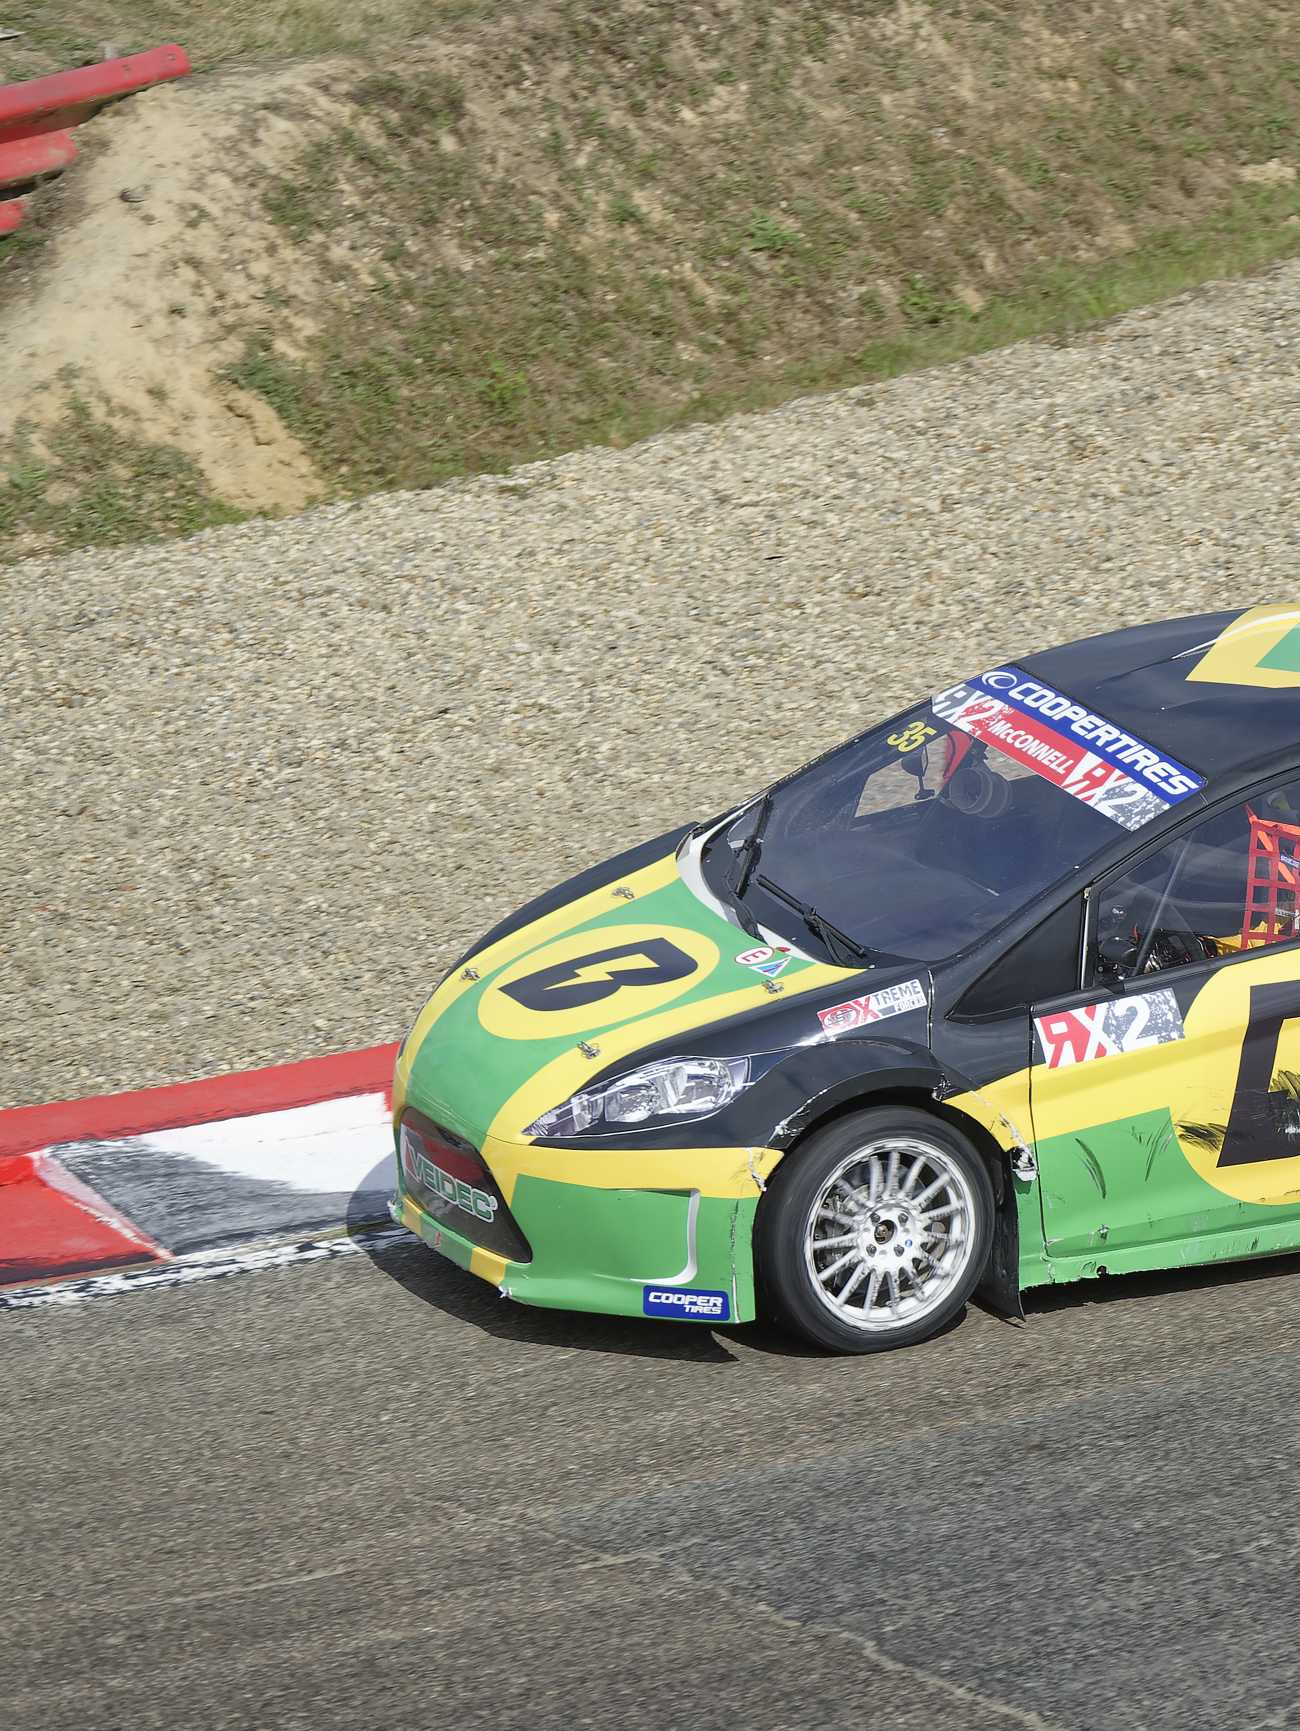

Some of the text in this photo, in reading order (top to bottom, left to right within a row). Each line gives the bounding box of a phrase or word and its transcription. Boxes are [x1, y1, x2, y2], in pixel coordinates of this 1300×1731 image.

[887, 721, 937, 752] 35
[988, 719, 1075, 775] McCONNELL
[404, 1136, 495, 1223] VEIDEC
[648, 1292, 723, 1307] COOPER
[684, 1304, 722, 1315] TIRES
